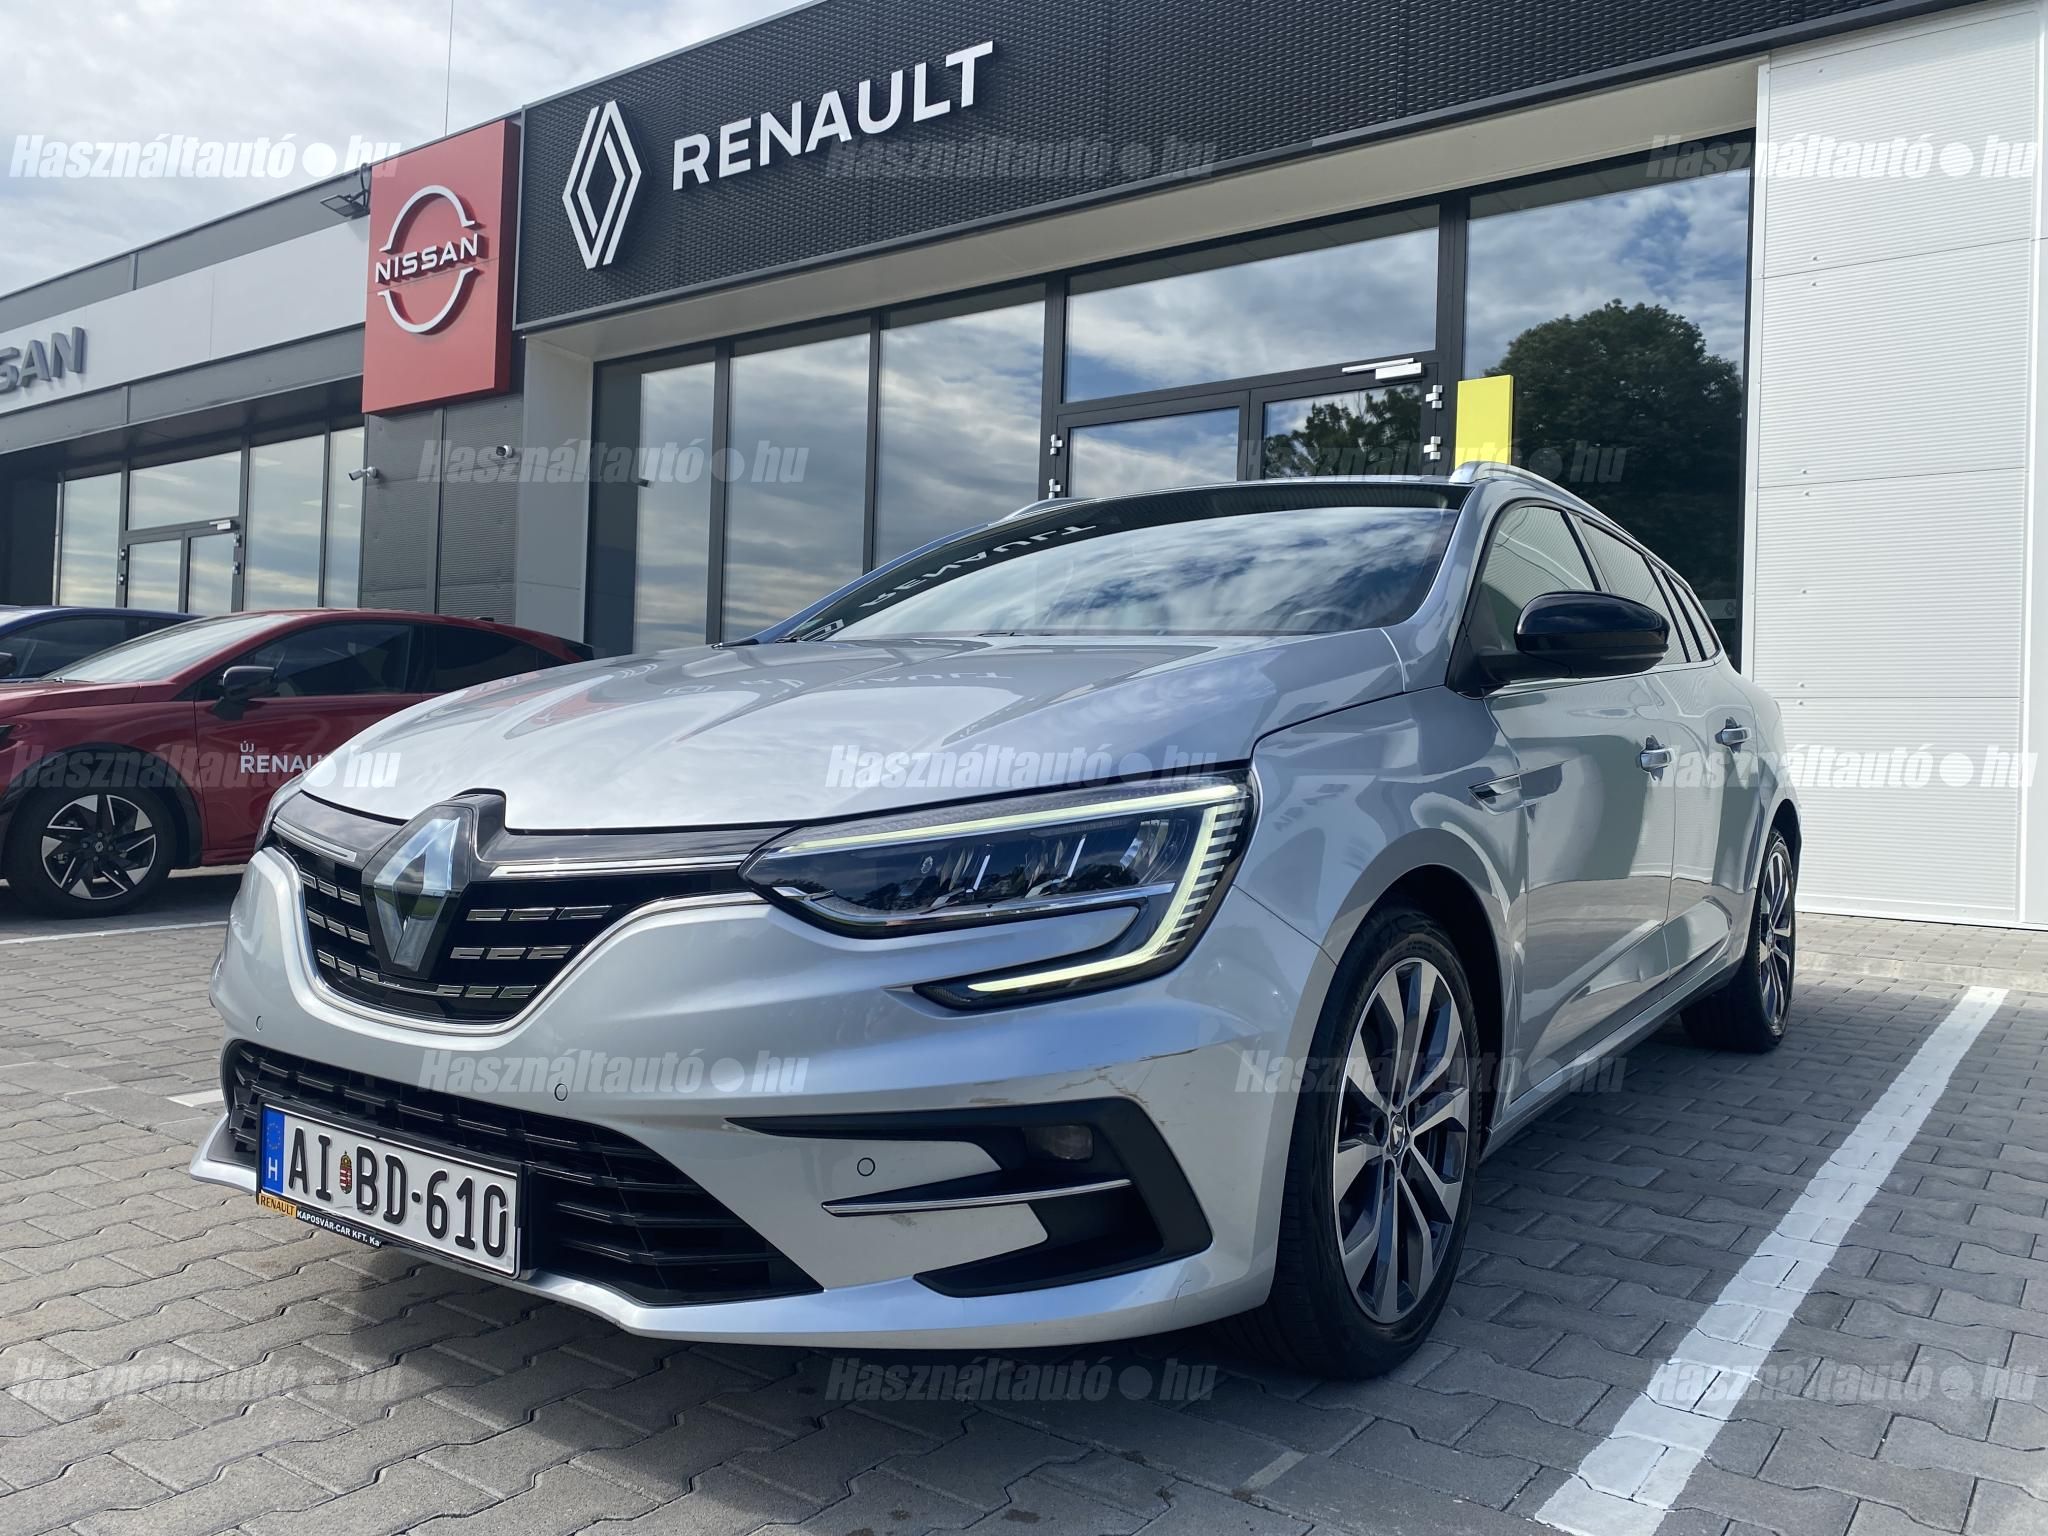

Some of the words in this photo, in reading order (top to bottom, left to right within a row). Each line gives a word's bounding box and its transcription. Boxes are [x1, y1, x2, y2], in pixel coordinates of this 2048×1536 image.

[673, 40, 993, 191] RENAULT
[375, 233, 478, 284] NISSAN
[240, 741, 255, 753] ÚJ
[267, 1157, 278, 1182] H
[260, 1195, 296, 1216] RENAULT
[352, 1230, 368, 1242] KFT.
[369, 1236, 381, 1247] Ka
